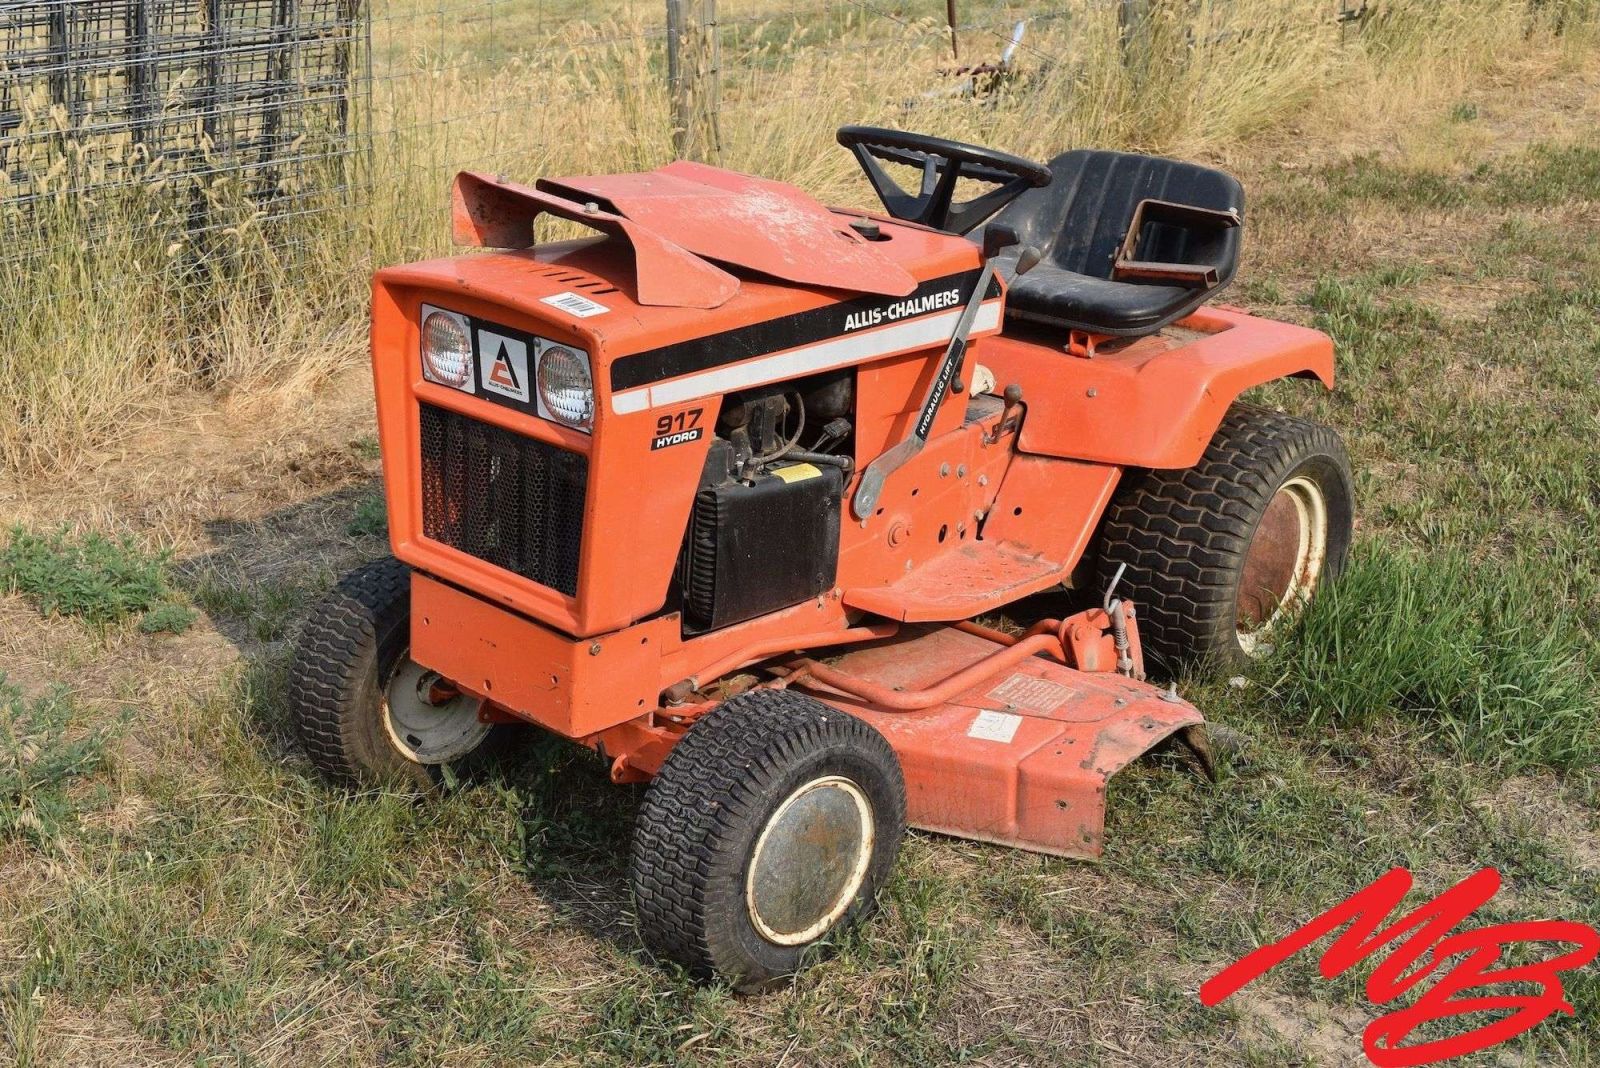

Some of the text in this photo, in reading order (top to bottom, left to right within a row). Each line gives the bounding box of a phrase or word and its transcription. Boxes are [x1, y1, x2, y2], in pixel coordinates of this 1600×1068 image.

[844, 288, 960, 331] ALLIS-CHALMERS
[920, 358, 953, 435] HYDRAULIC LIFT
[655, 407, 704, 436] 917
[656, 429, 698, 448] HYDRO
